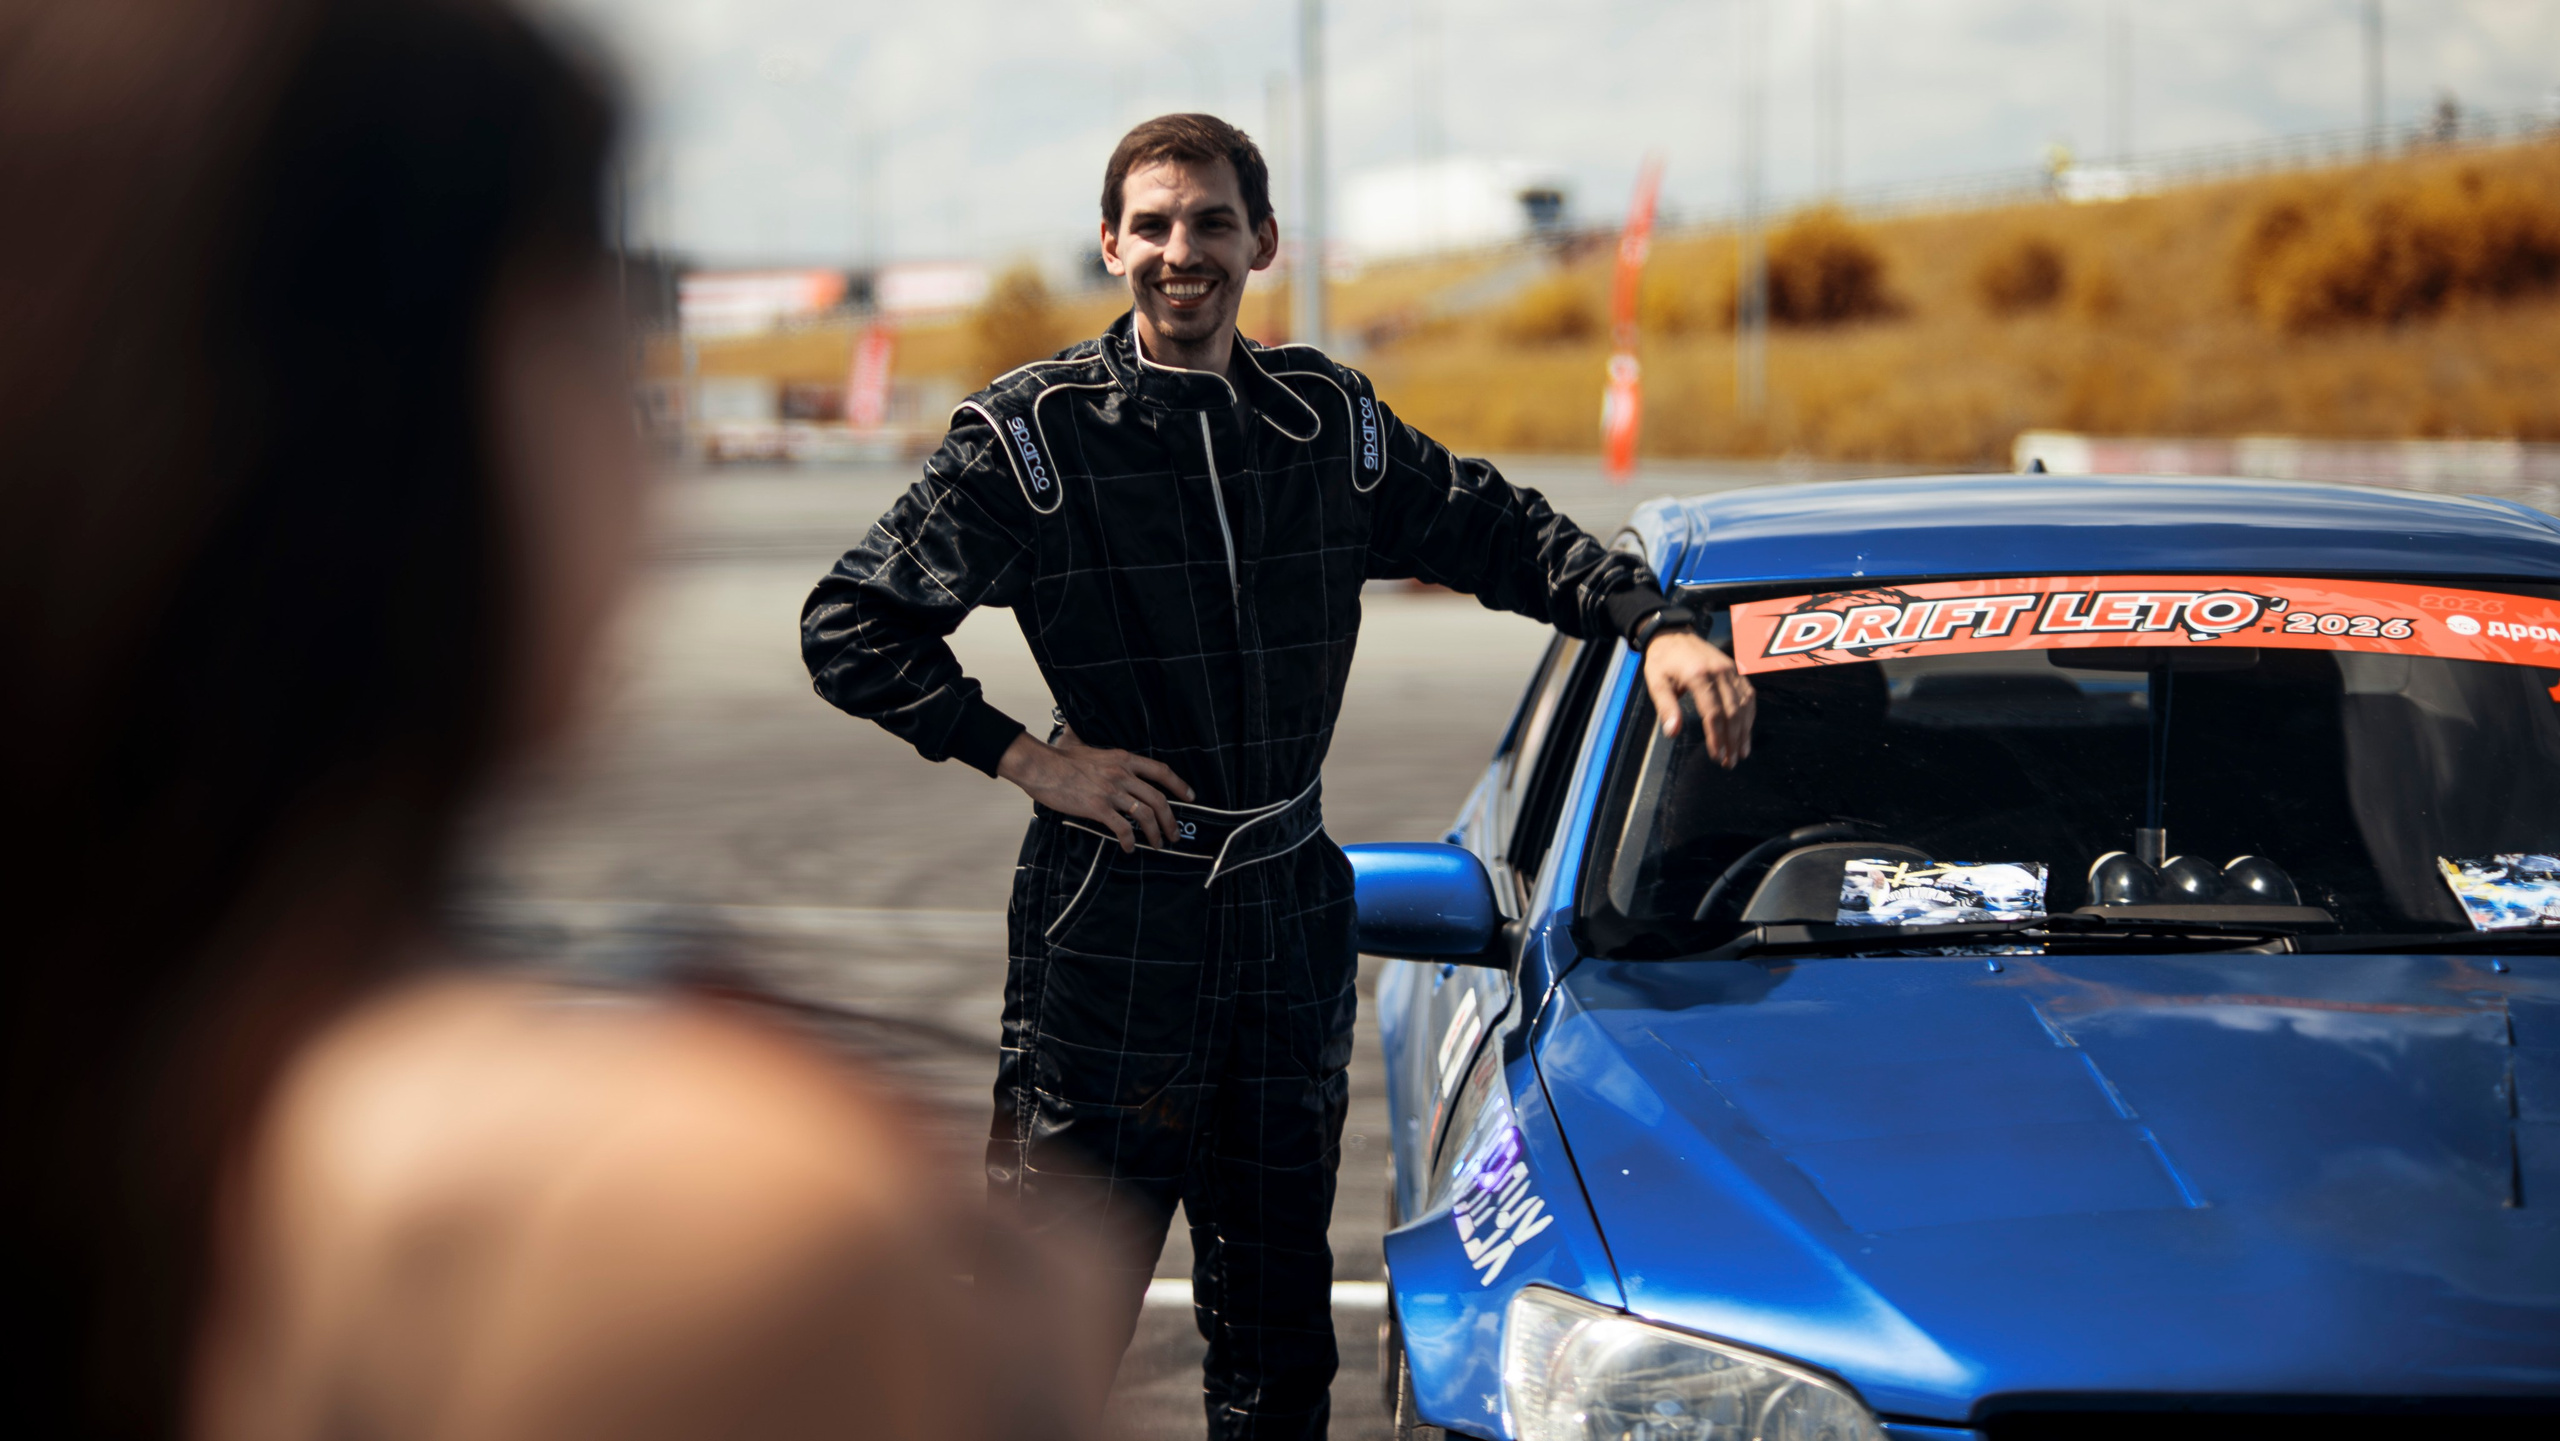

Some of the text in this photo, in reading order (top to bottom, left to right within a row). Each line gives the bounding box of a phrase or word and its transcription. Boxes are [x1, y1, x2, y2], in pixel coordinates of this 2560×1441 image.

[1008, 415, 1050, 491] sparco
[1363, 396, 1378, 470] sparco
[1766, 589, 2413, 655] DRIFT LETO 2026
[2419, 593, 2504, 615] 2026
